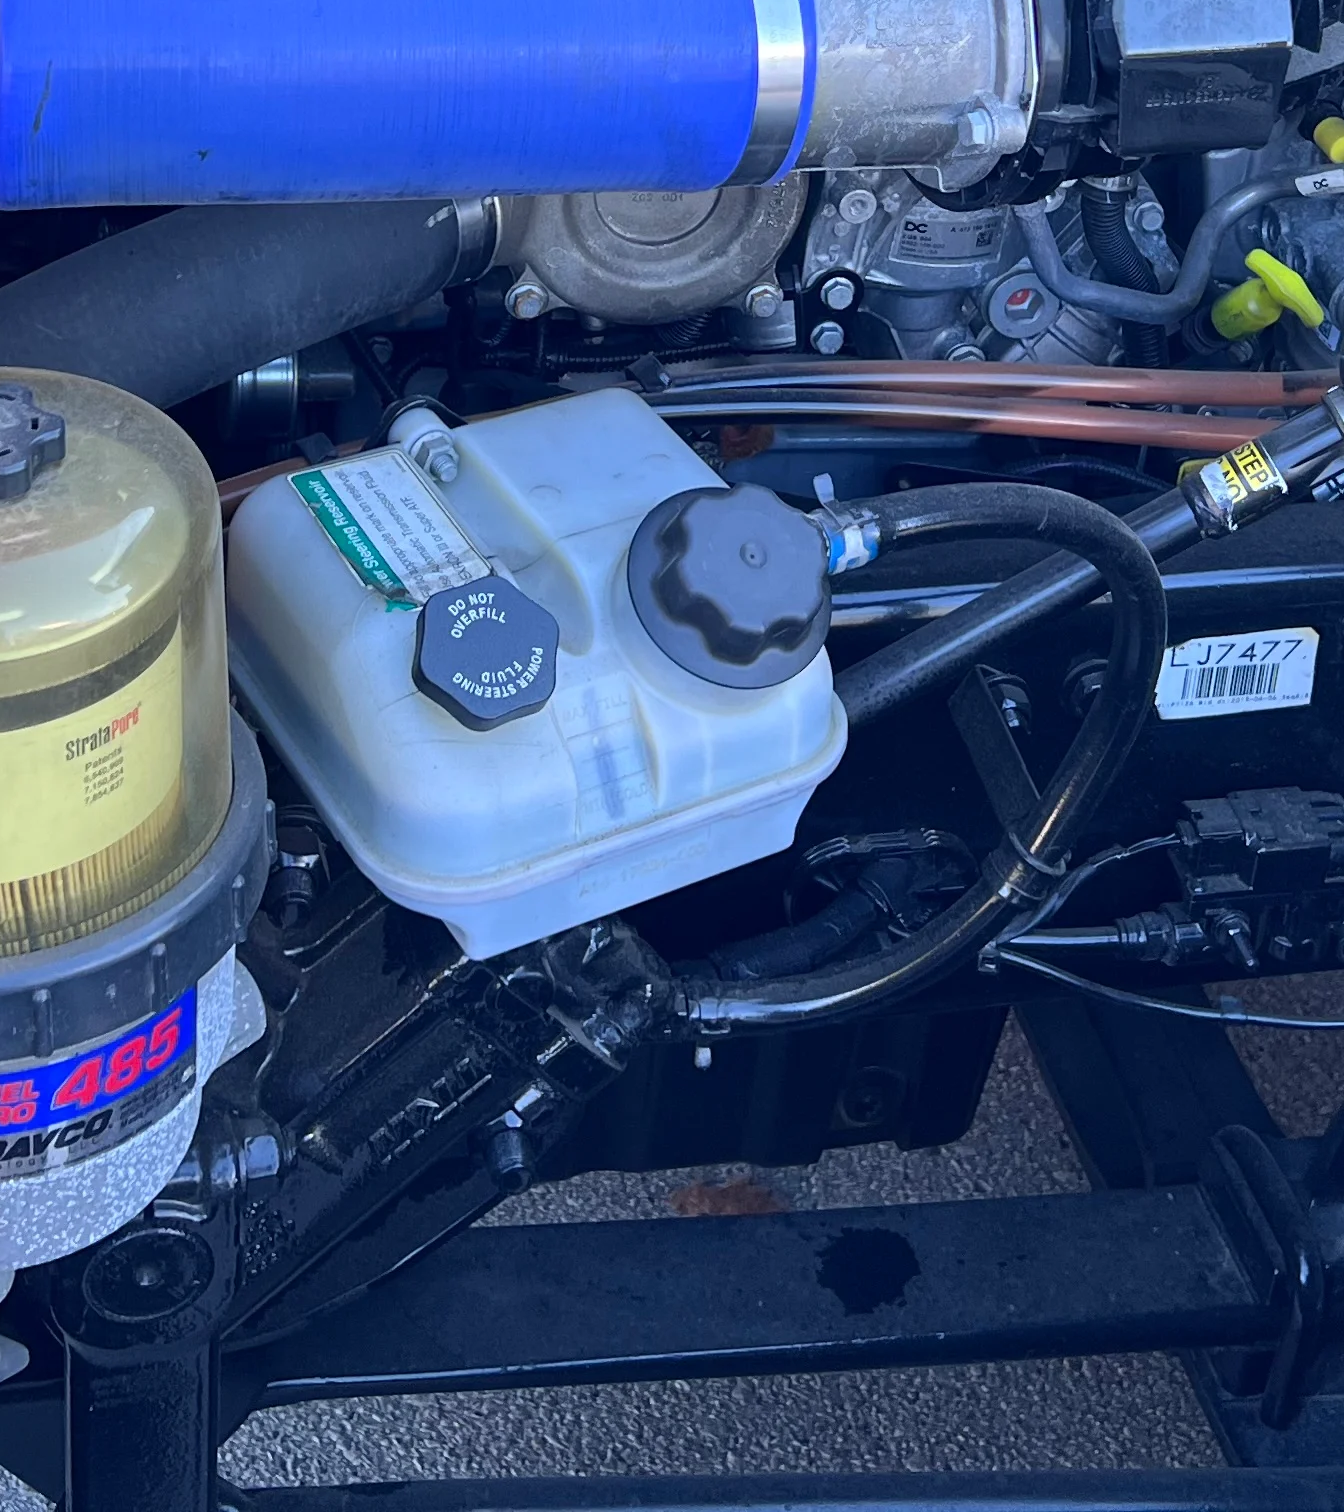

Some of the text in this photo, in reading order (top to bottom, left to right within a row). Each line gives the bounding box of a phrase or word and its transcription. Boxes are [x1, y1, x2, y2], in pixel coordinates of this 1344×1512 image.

[1313, 178, 1329, 190] DC
[904, 221, 928, 233] DC
[1235, 444, 1269, 484] STEP
[308, 480, 348, 527] Reservoir
[358, 501, 372, 513] on
[373, 488, 413, 539] Transmission
[365, 512, 385, 533] mark
[414, 508, 436, 535] Super
[343, 525, 380, 569] Steering
[448, 592, 495, 616] DO NOT
[450, 607, 506, 639] OVERFILL
[452, 646, 544, 699] POWER STEERING
[481, 660, 523, 684] FLUID
[65, 706, 140, 761] StrataPore
[85, 746, 122, 772] Patents
[50, 1007, 182, 1111] 485
